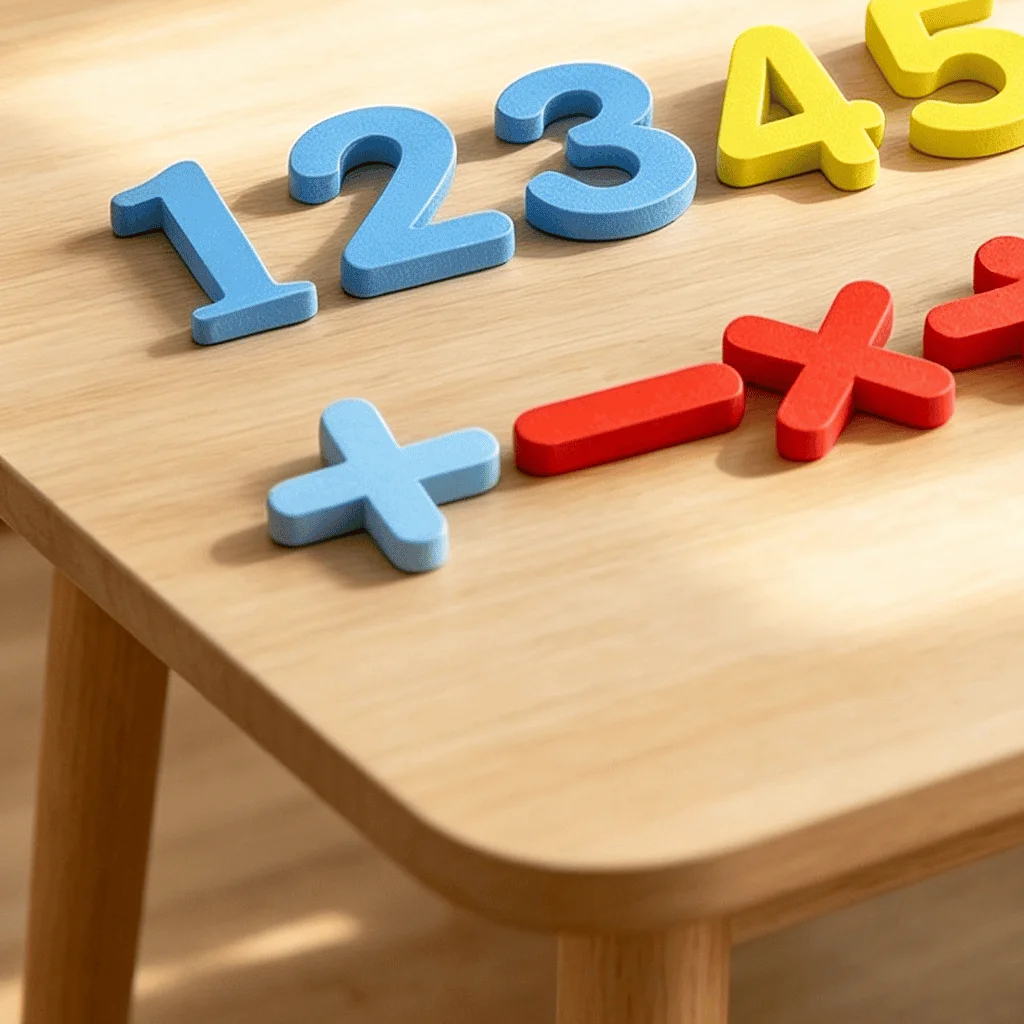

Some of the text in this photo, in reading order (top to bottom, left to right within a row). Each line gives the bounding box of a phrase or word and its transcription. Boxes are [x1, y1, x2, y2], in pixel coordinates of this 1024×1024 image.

[110, 160, 317, 346] 1
[289, 106, 514, 298] 2
[495, 62, 696, 241] 3
[716, 25, 885, 189] 4
